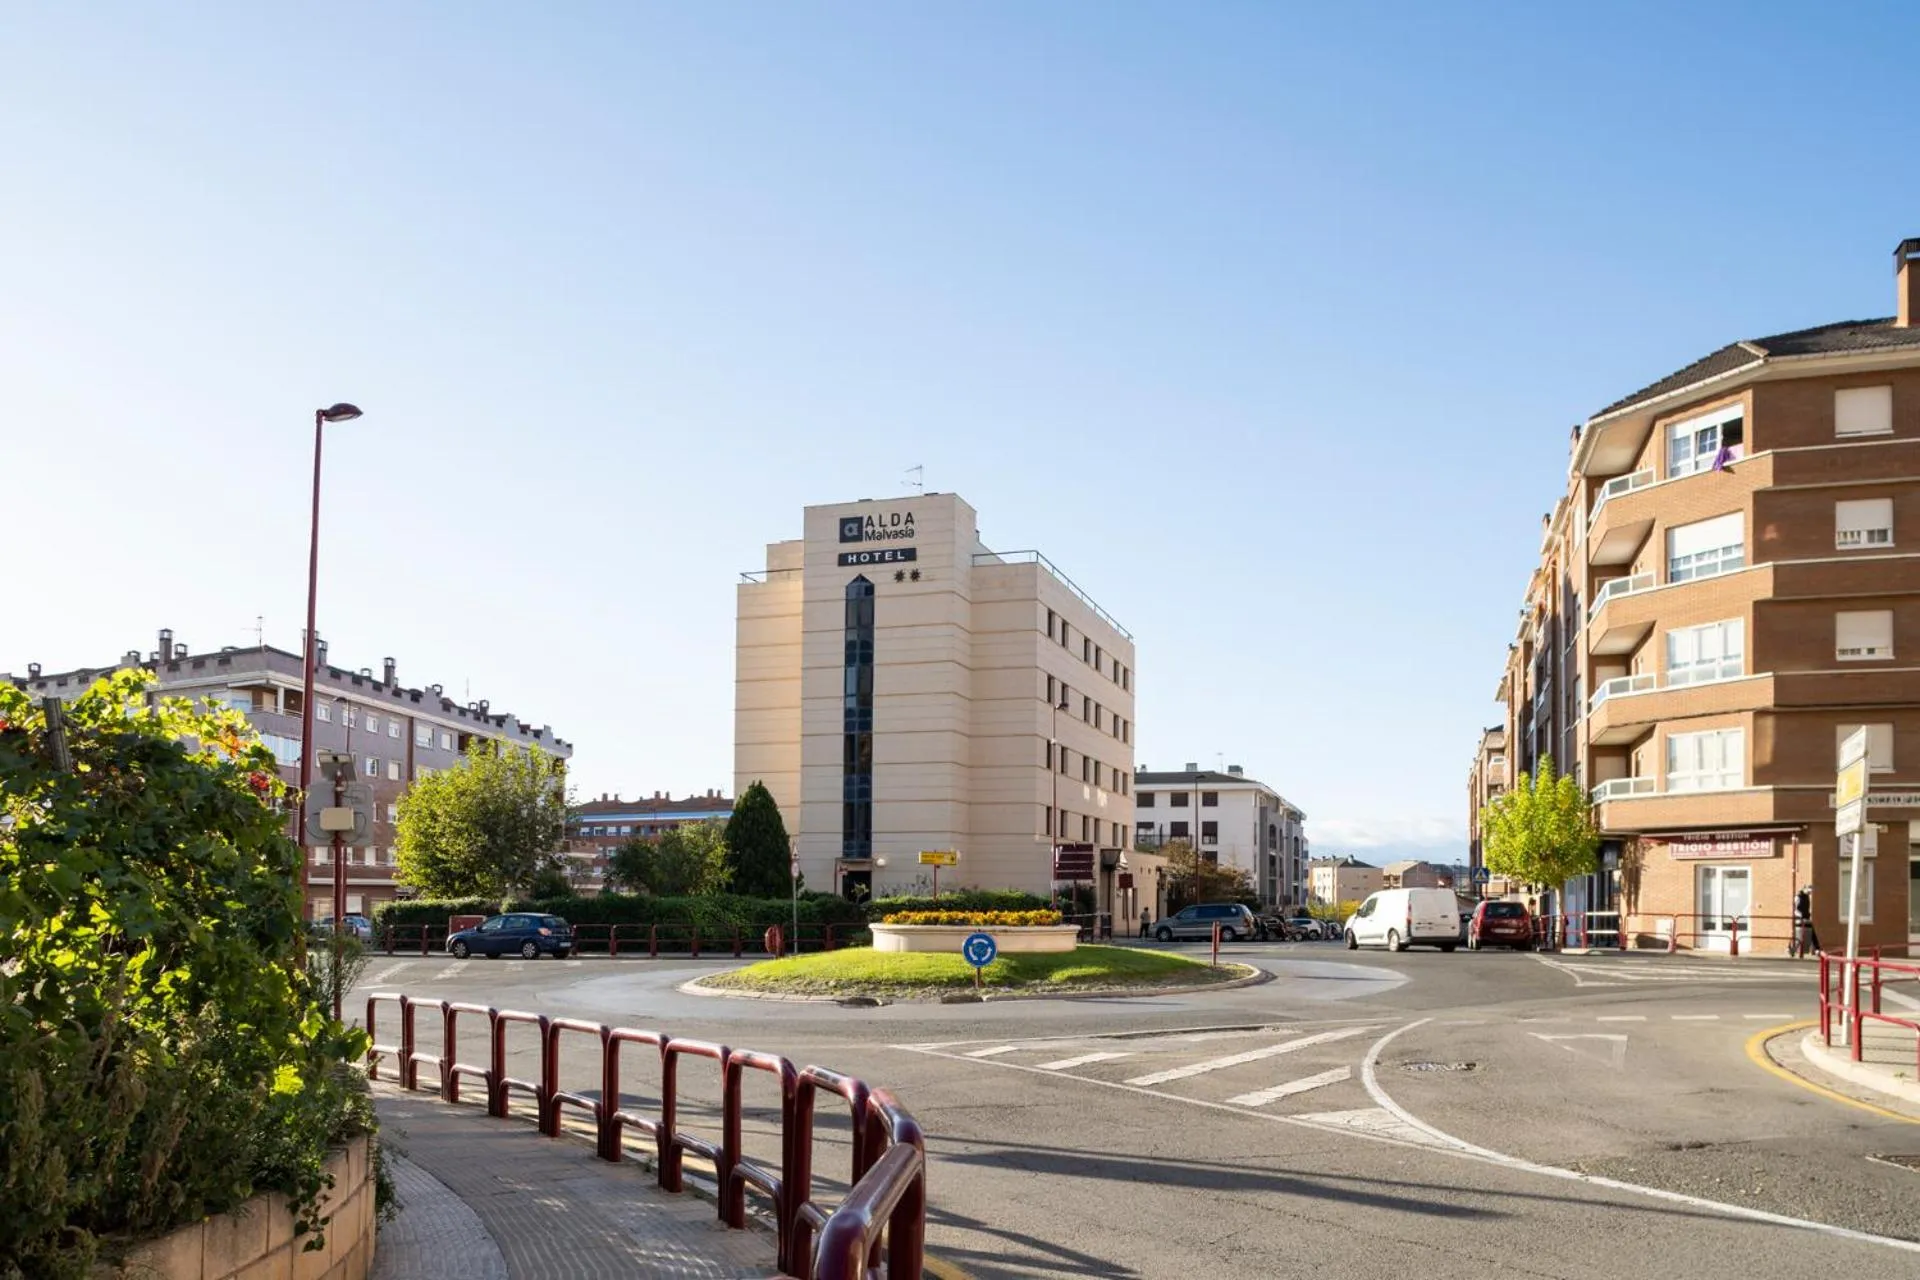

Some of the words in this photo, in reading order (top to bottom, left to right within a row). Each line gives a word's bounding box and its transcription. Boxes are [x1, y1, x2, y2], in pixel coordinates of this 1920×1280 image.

[865, 512, 915, 528] ALDA
[847, 551, 905, 564] HOTEL
[1672, 843, 1712, 852] TRICIO
